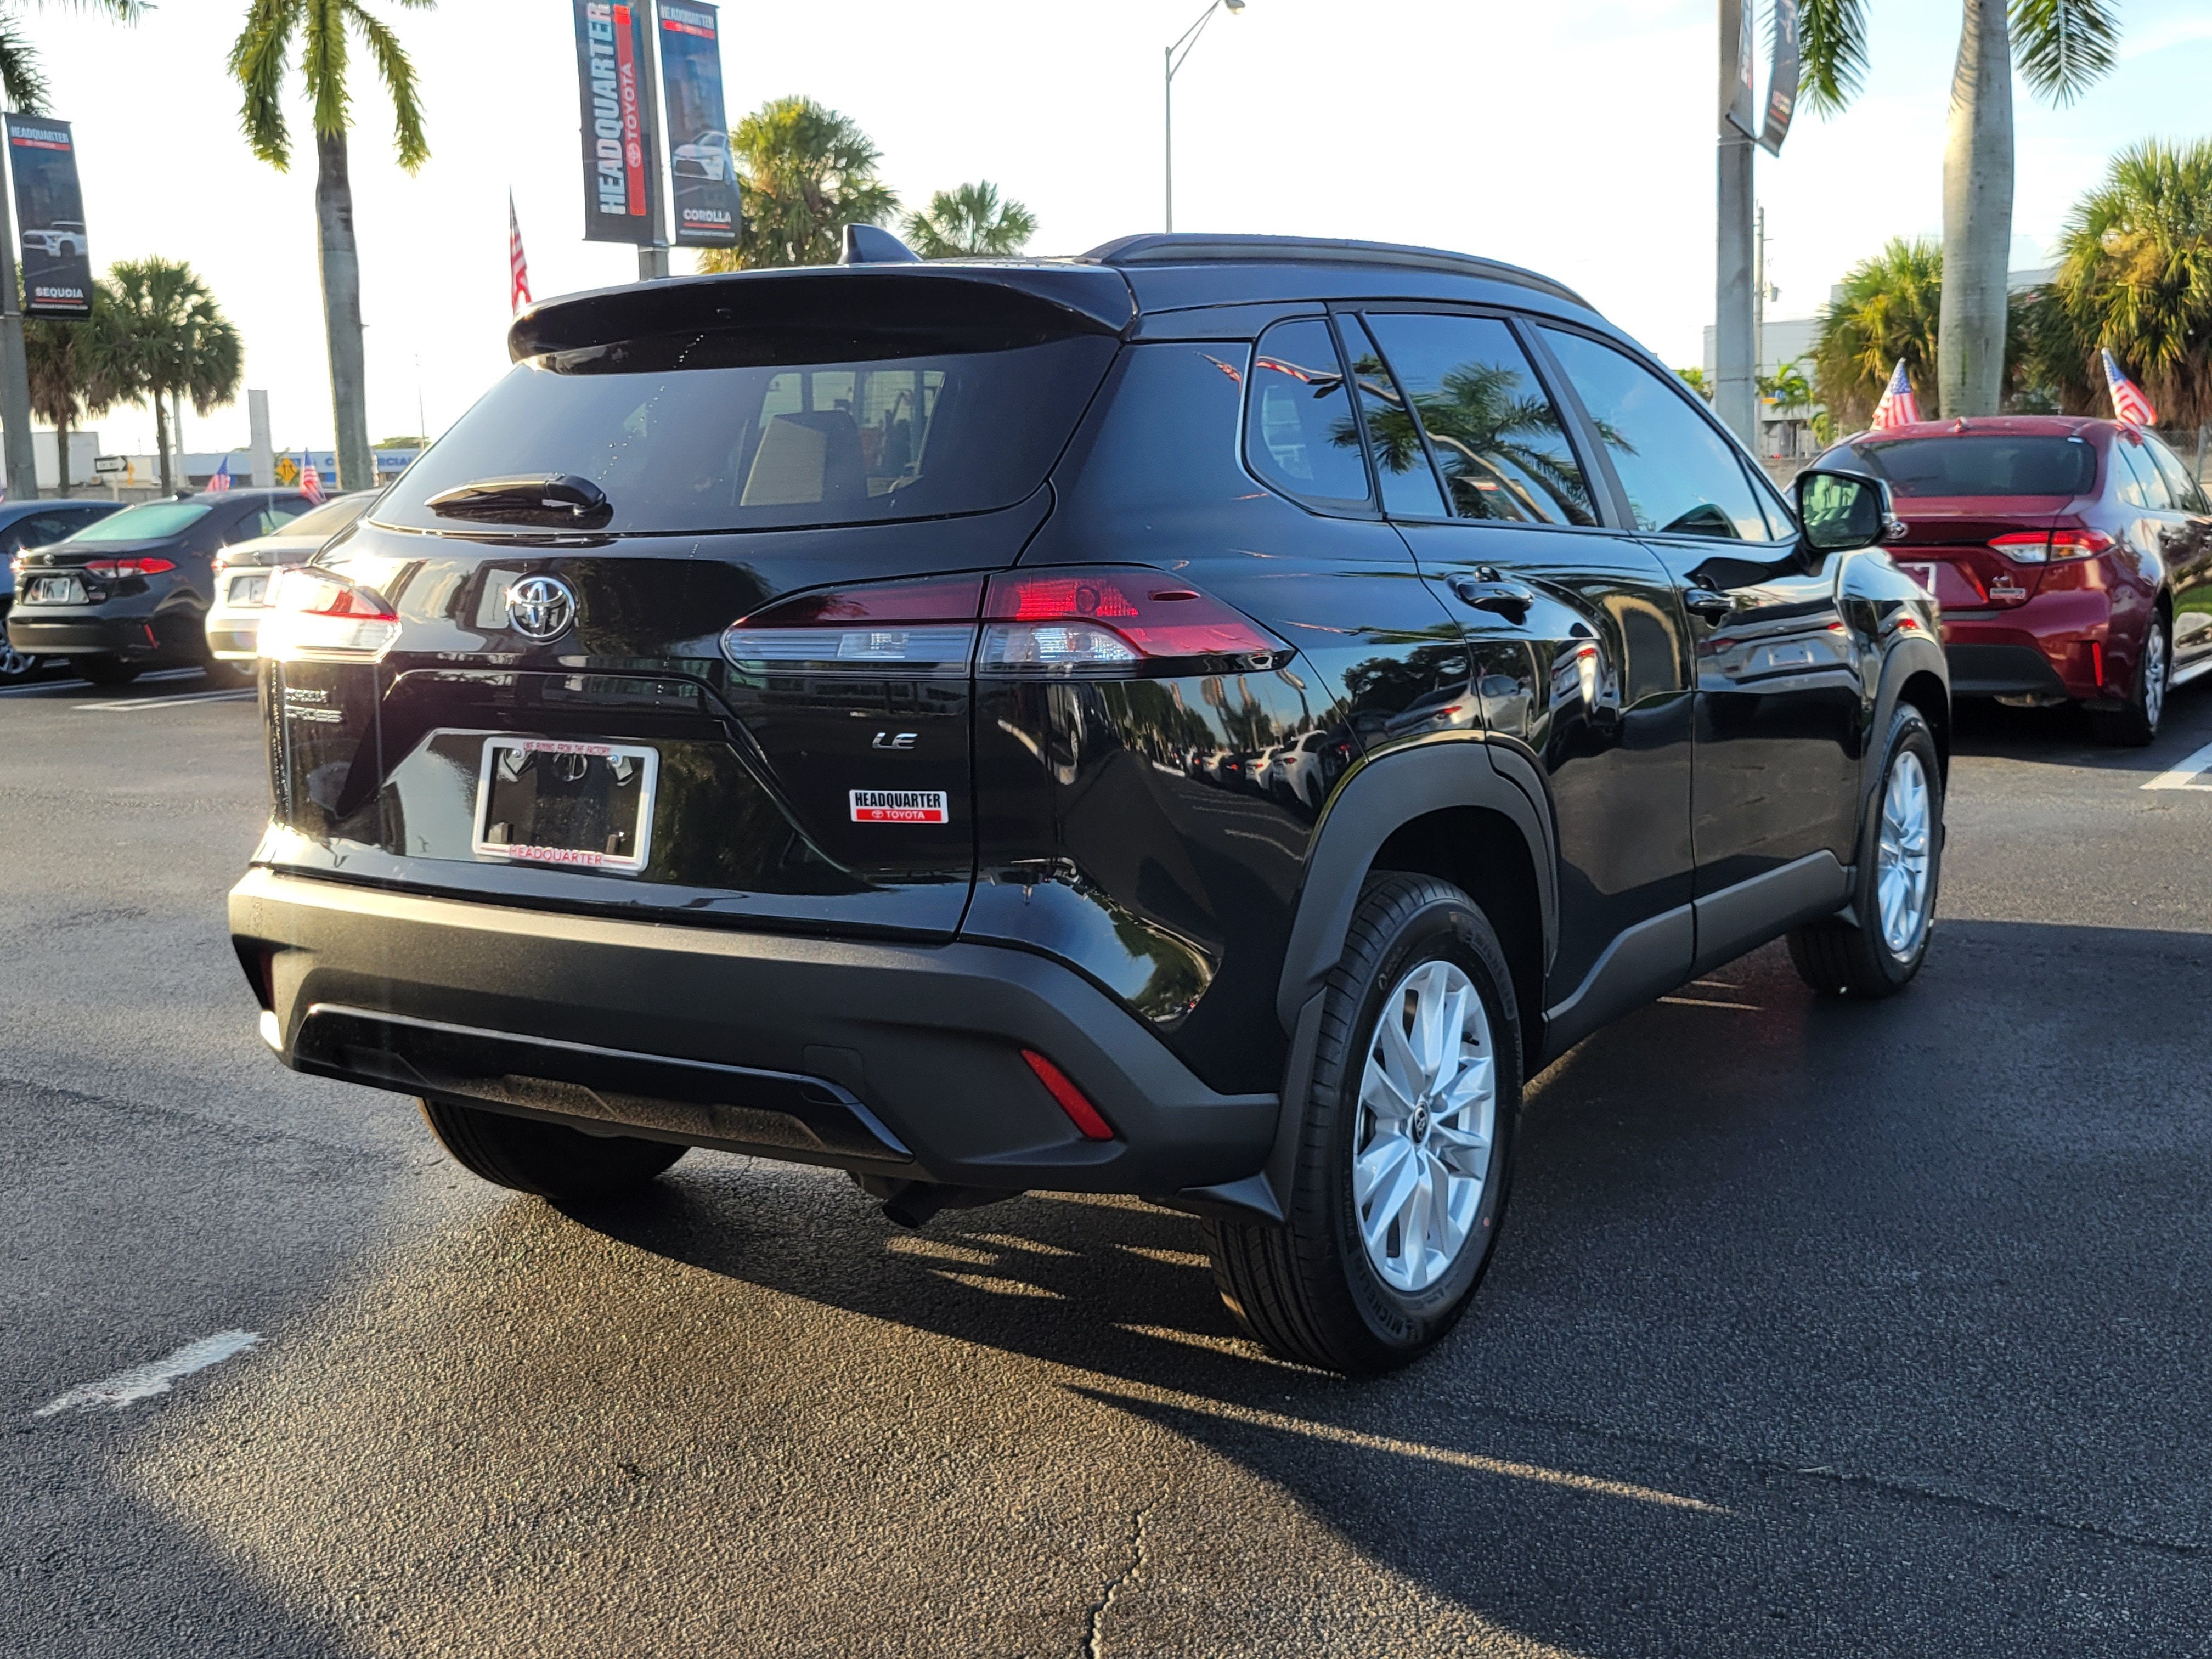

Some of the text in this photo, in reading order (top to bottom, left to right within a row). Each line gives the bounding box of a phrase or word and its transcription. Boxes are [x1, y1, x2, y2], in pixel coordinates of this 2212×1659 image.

[587, 2, 627, 215] HEADQUARTER
[620, 61, 639, 140] TOYOTA
[10, 126, 69, 143] HEADQUARTER
[682, 208, 732, 223] COROLLA
[35, 286, 84, 298] SEQUOIA
[872, 732, 918, 750] LE
[855, 792, 941, 808] HEADQUARTER
[886, 810, 925, 819] TOYOTA
[509, 844, 602, 865] HEADQUARTER
